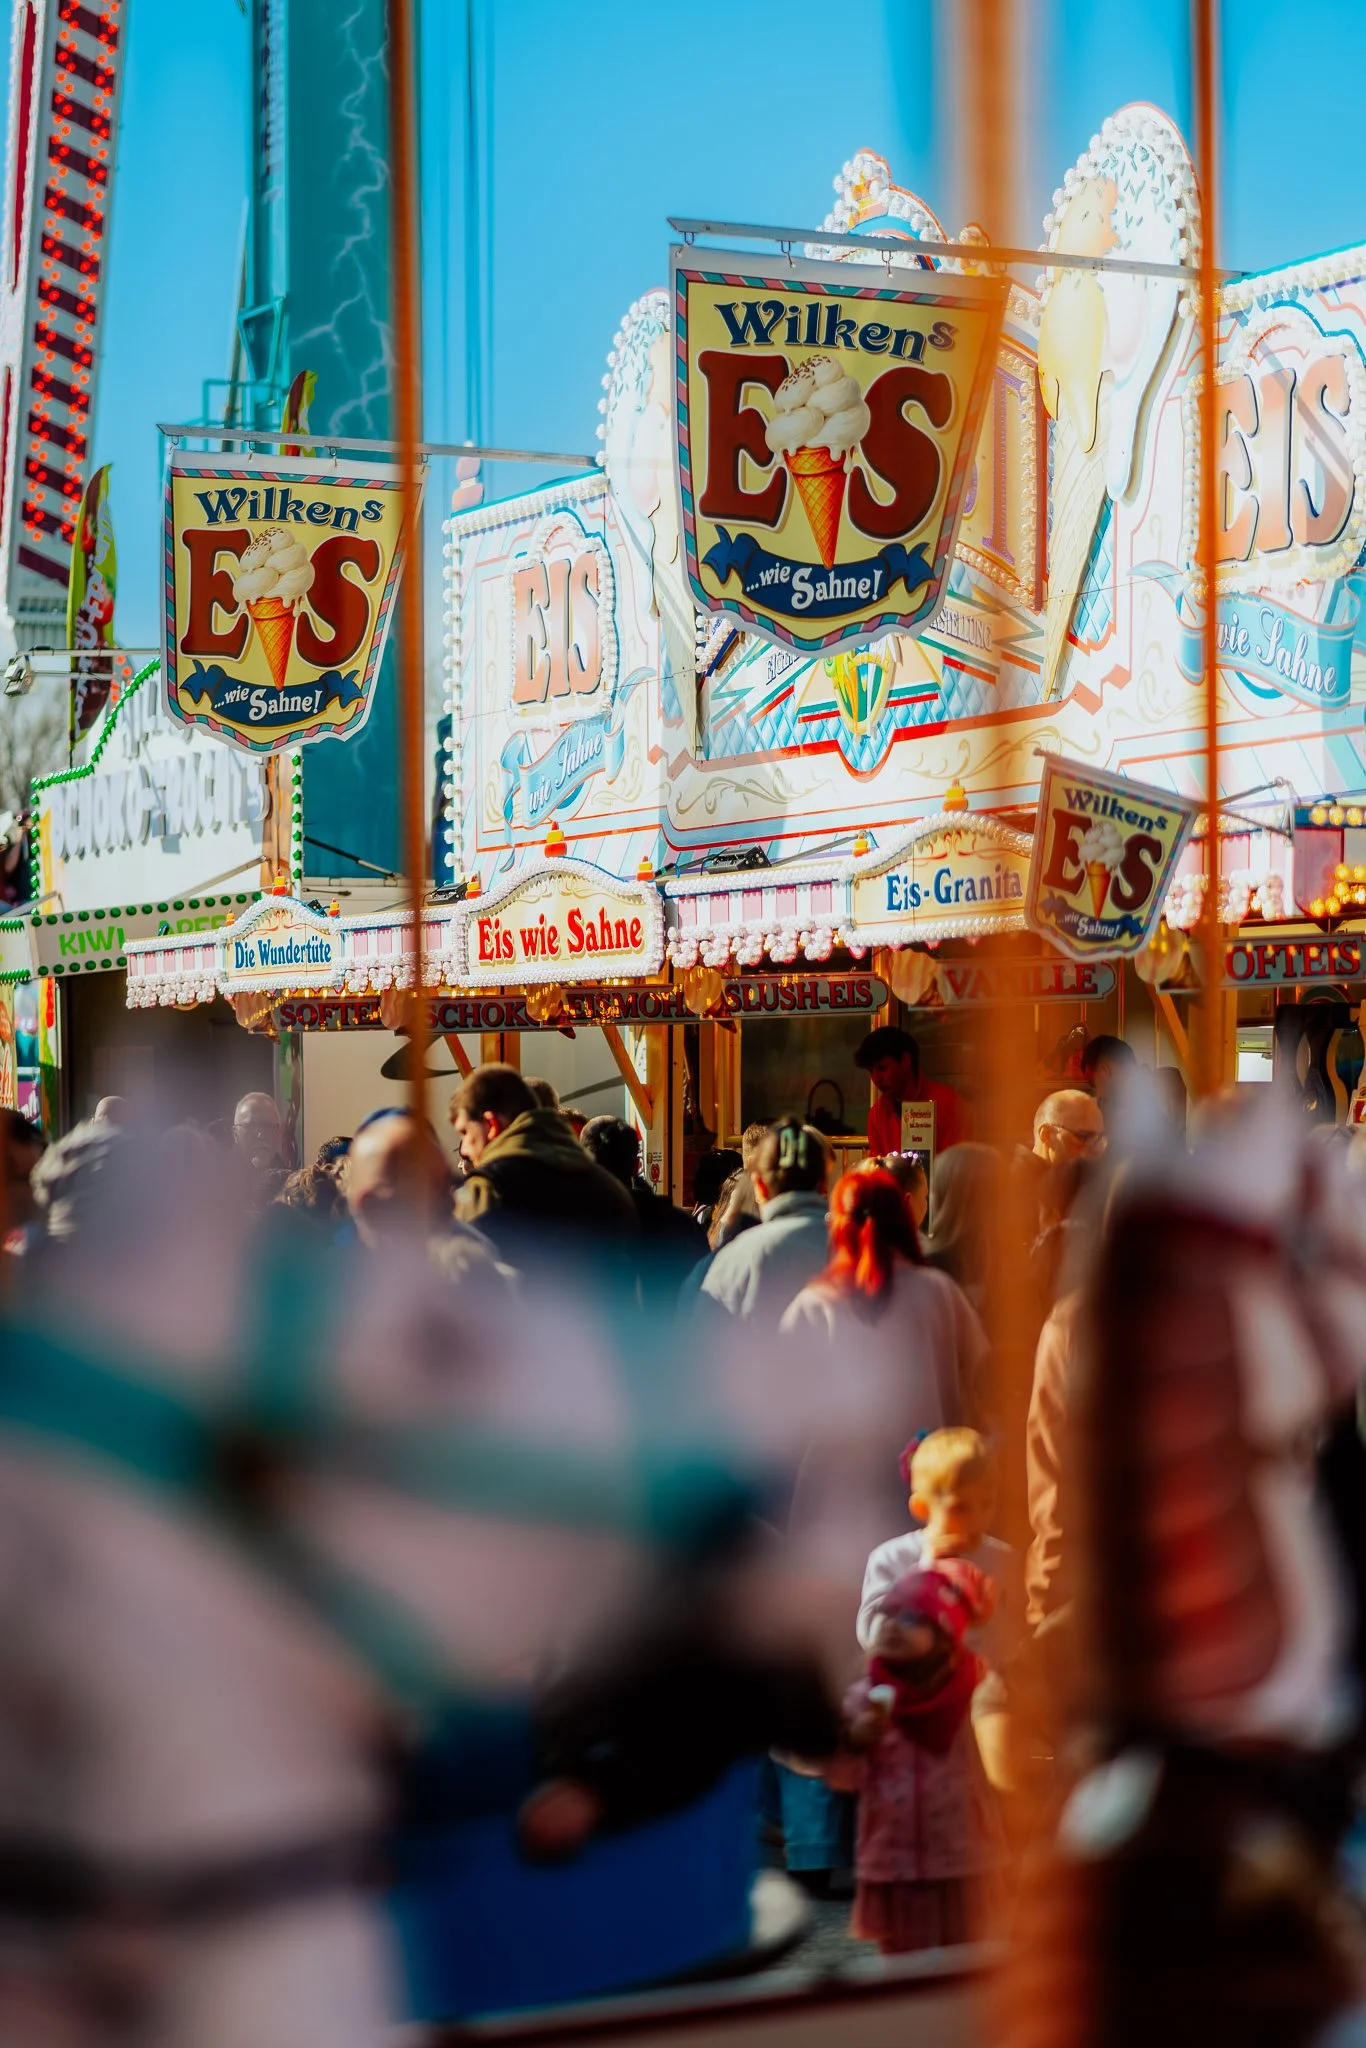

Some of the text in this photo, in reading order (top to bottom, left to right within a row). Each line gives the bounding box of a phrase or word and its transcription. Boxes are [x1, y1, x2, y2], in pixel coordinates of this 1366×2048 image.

[714, 301, 956, 364] Wilkens
[1195, 353, 1356, 564] EIS
[193, 486, 384, 533] Wilkens
[790, 564, 881, 610] Sahne!
[513, 552, 602, 706] EIS
[1255, 607, 1337, 695] Sahne
[249, 688, 321, 722] Sahne!
[528, 729, 603, 814] wie Sahne
[1062, 786, 1169, 833] Wilkens
[59, 925, 125, 957] KIWI
[477, 906, 644, 961] Eis wie Sahne
[1077, 917, 1121, 938] Sahne!
[234, 935, 332, 968] Die Wundertüte
[1224, 940, 1361, 981] OFTEIS
[723, 978, 874, 1013] SLUSH-EIS
